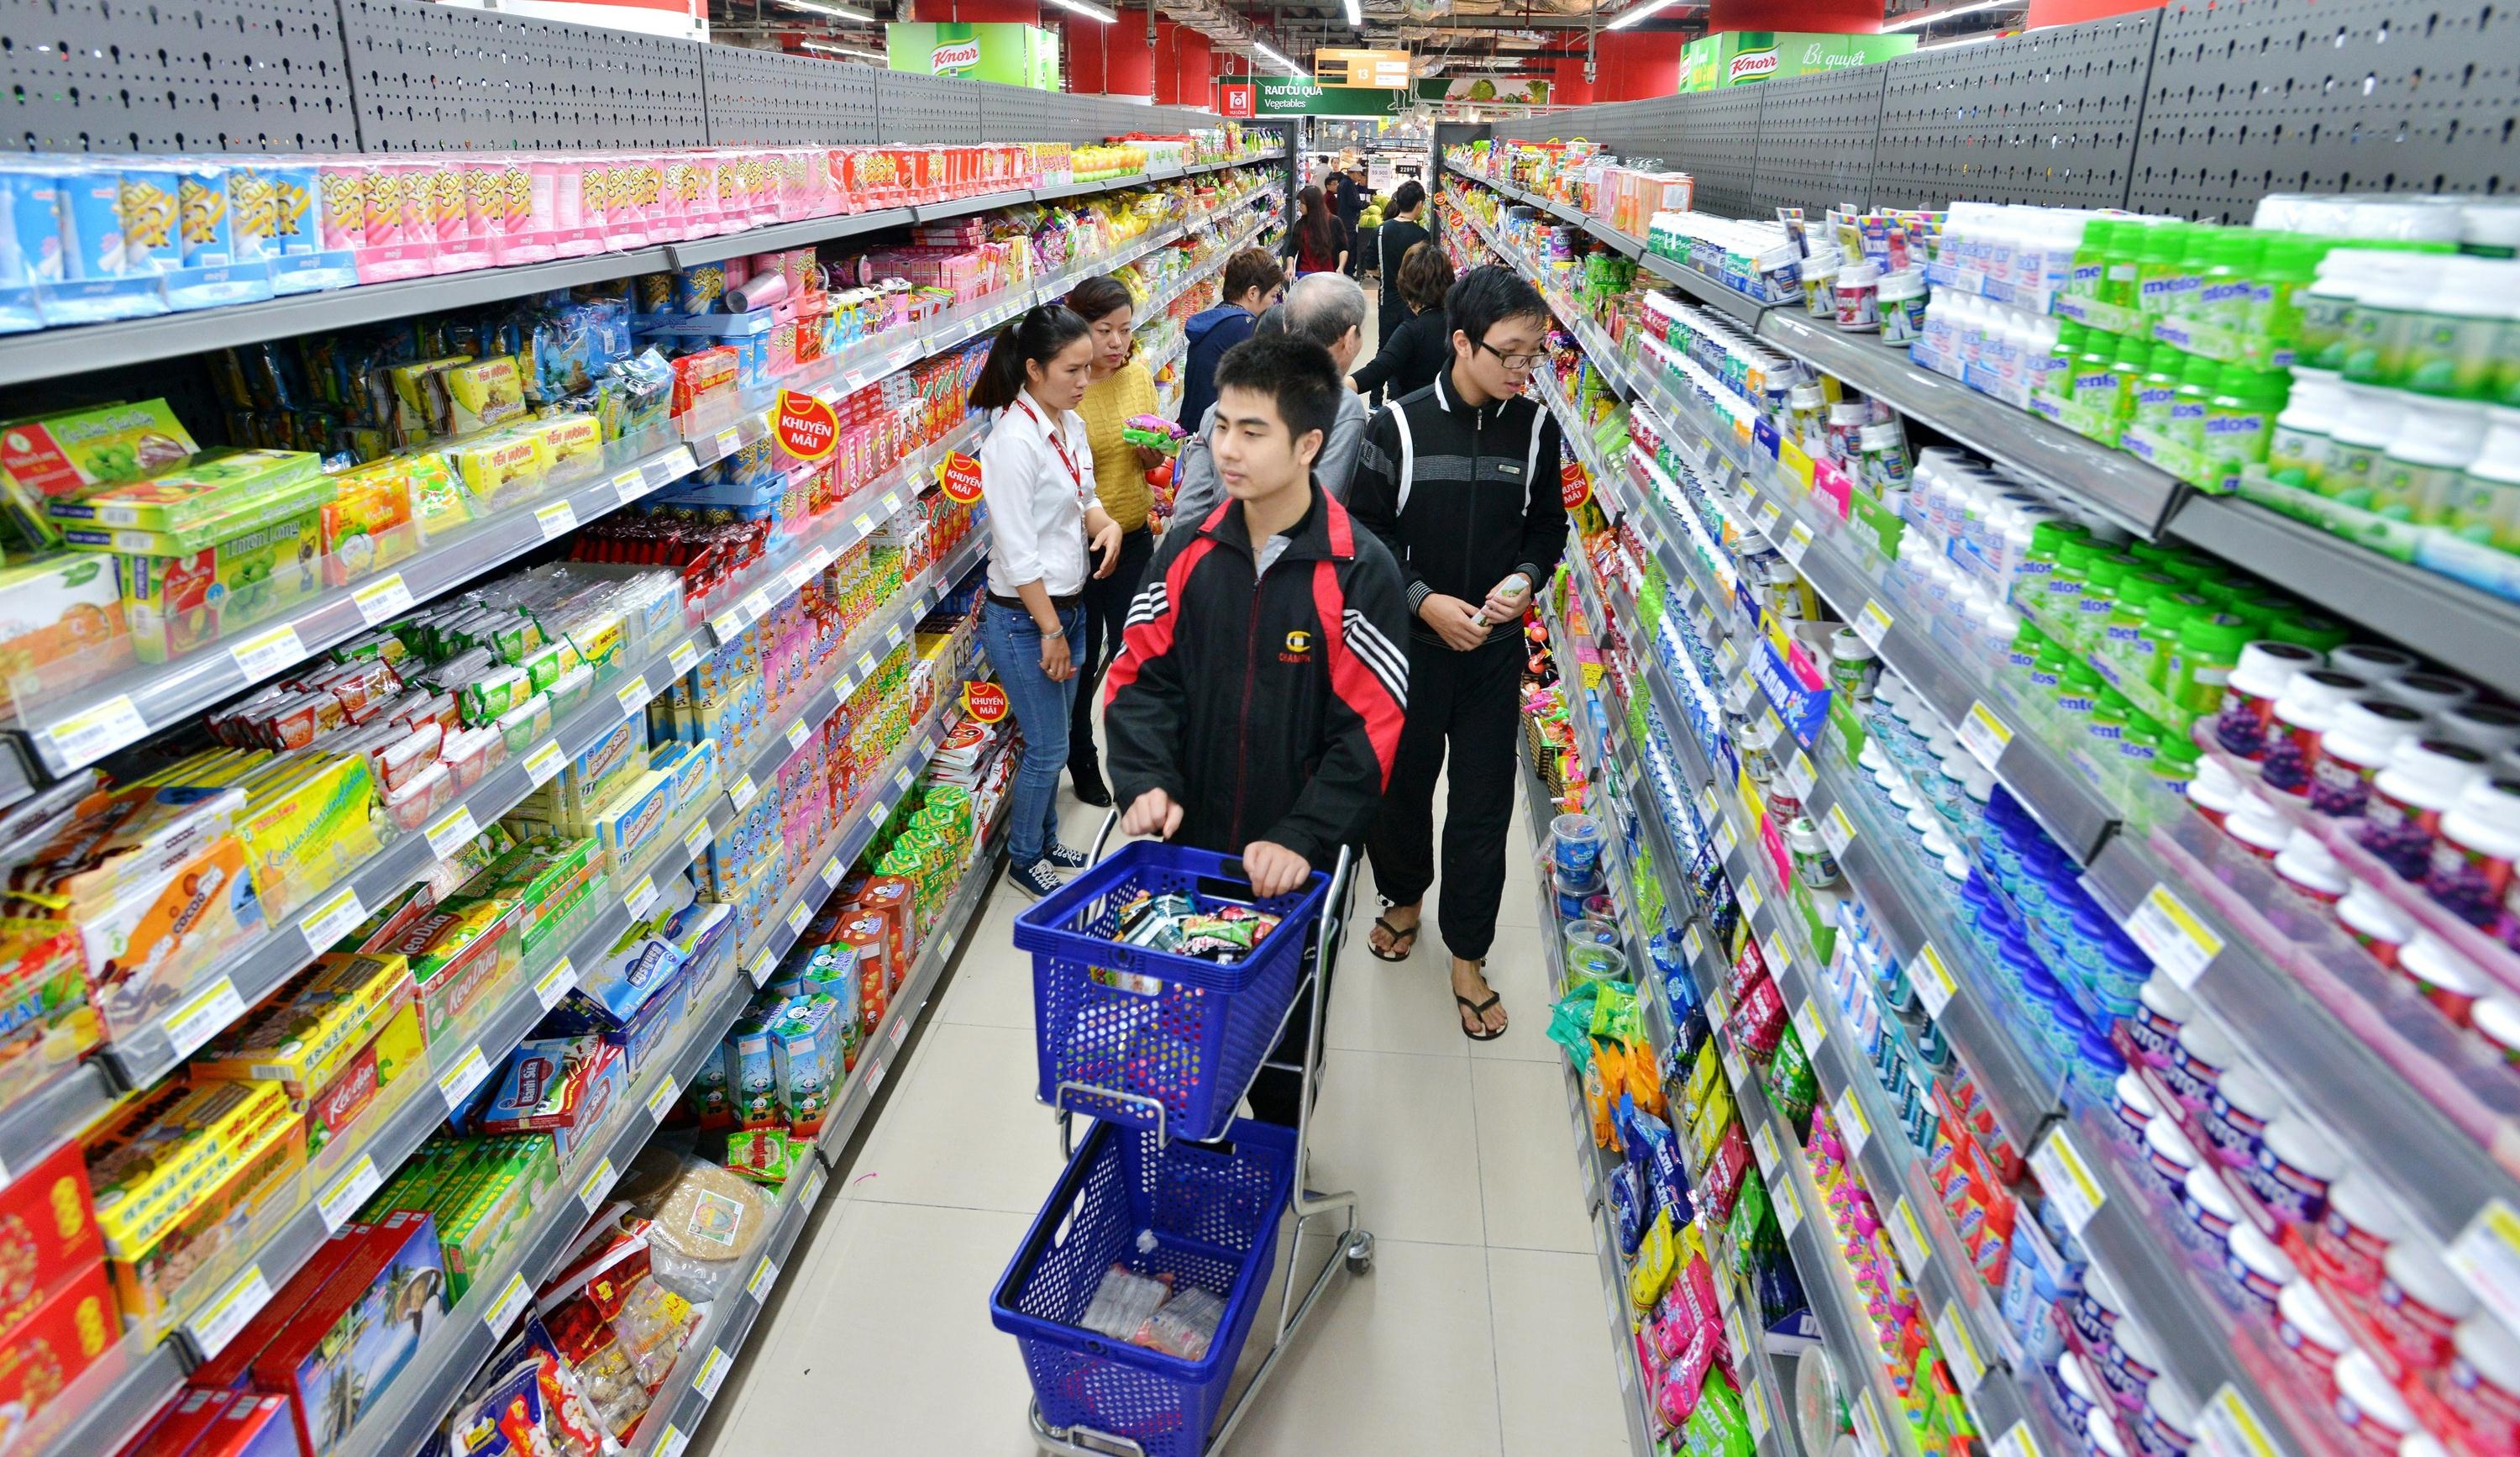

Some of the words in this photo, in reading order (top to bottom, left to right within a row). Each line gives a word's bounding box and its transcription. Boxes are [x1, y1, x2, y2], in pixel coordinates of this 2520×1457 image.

[932, 48, 978, 68] Knorr
[1802, 43, 1822, 65] Bí
[1357, 69, 1369, 80] 13
[1730, 55, 1778, 76] Knorr
[1264, 99, 1306, 109] Vegetables
[299, 256, 320, 269] meiji
[203, 270, 228, 282] meiji
[781, 414, 832, 438] KHUYẾN
[790, 433, 819, 450] MÃI
[879, 422, 888, 471] LUCKY
[848, 436, 859, 490] LUCKY
[864, 429, 874, 480] LUCKY
[952, 481, 972, 496] MÃI
[1565, 491, 1583, 504] MÃI
[970, 695, 1004, 706] KHUYẾN
[979, 703, 997, 714] MÃI
[172, 892, 206, 934] cacao
[801, 1002, 822, 1025] HELLO
[809, 1002, 832, 1026] PANDA
[522, 1060, 539, 1079] Sữa
[521, 1079, 538, 1103] Bánh
